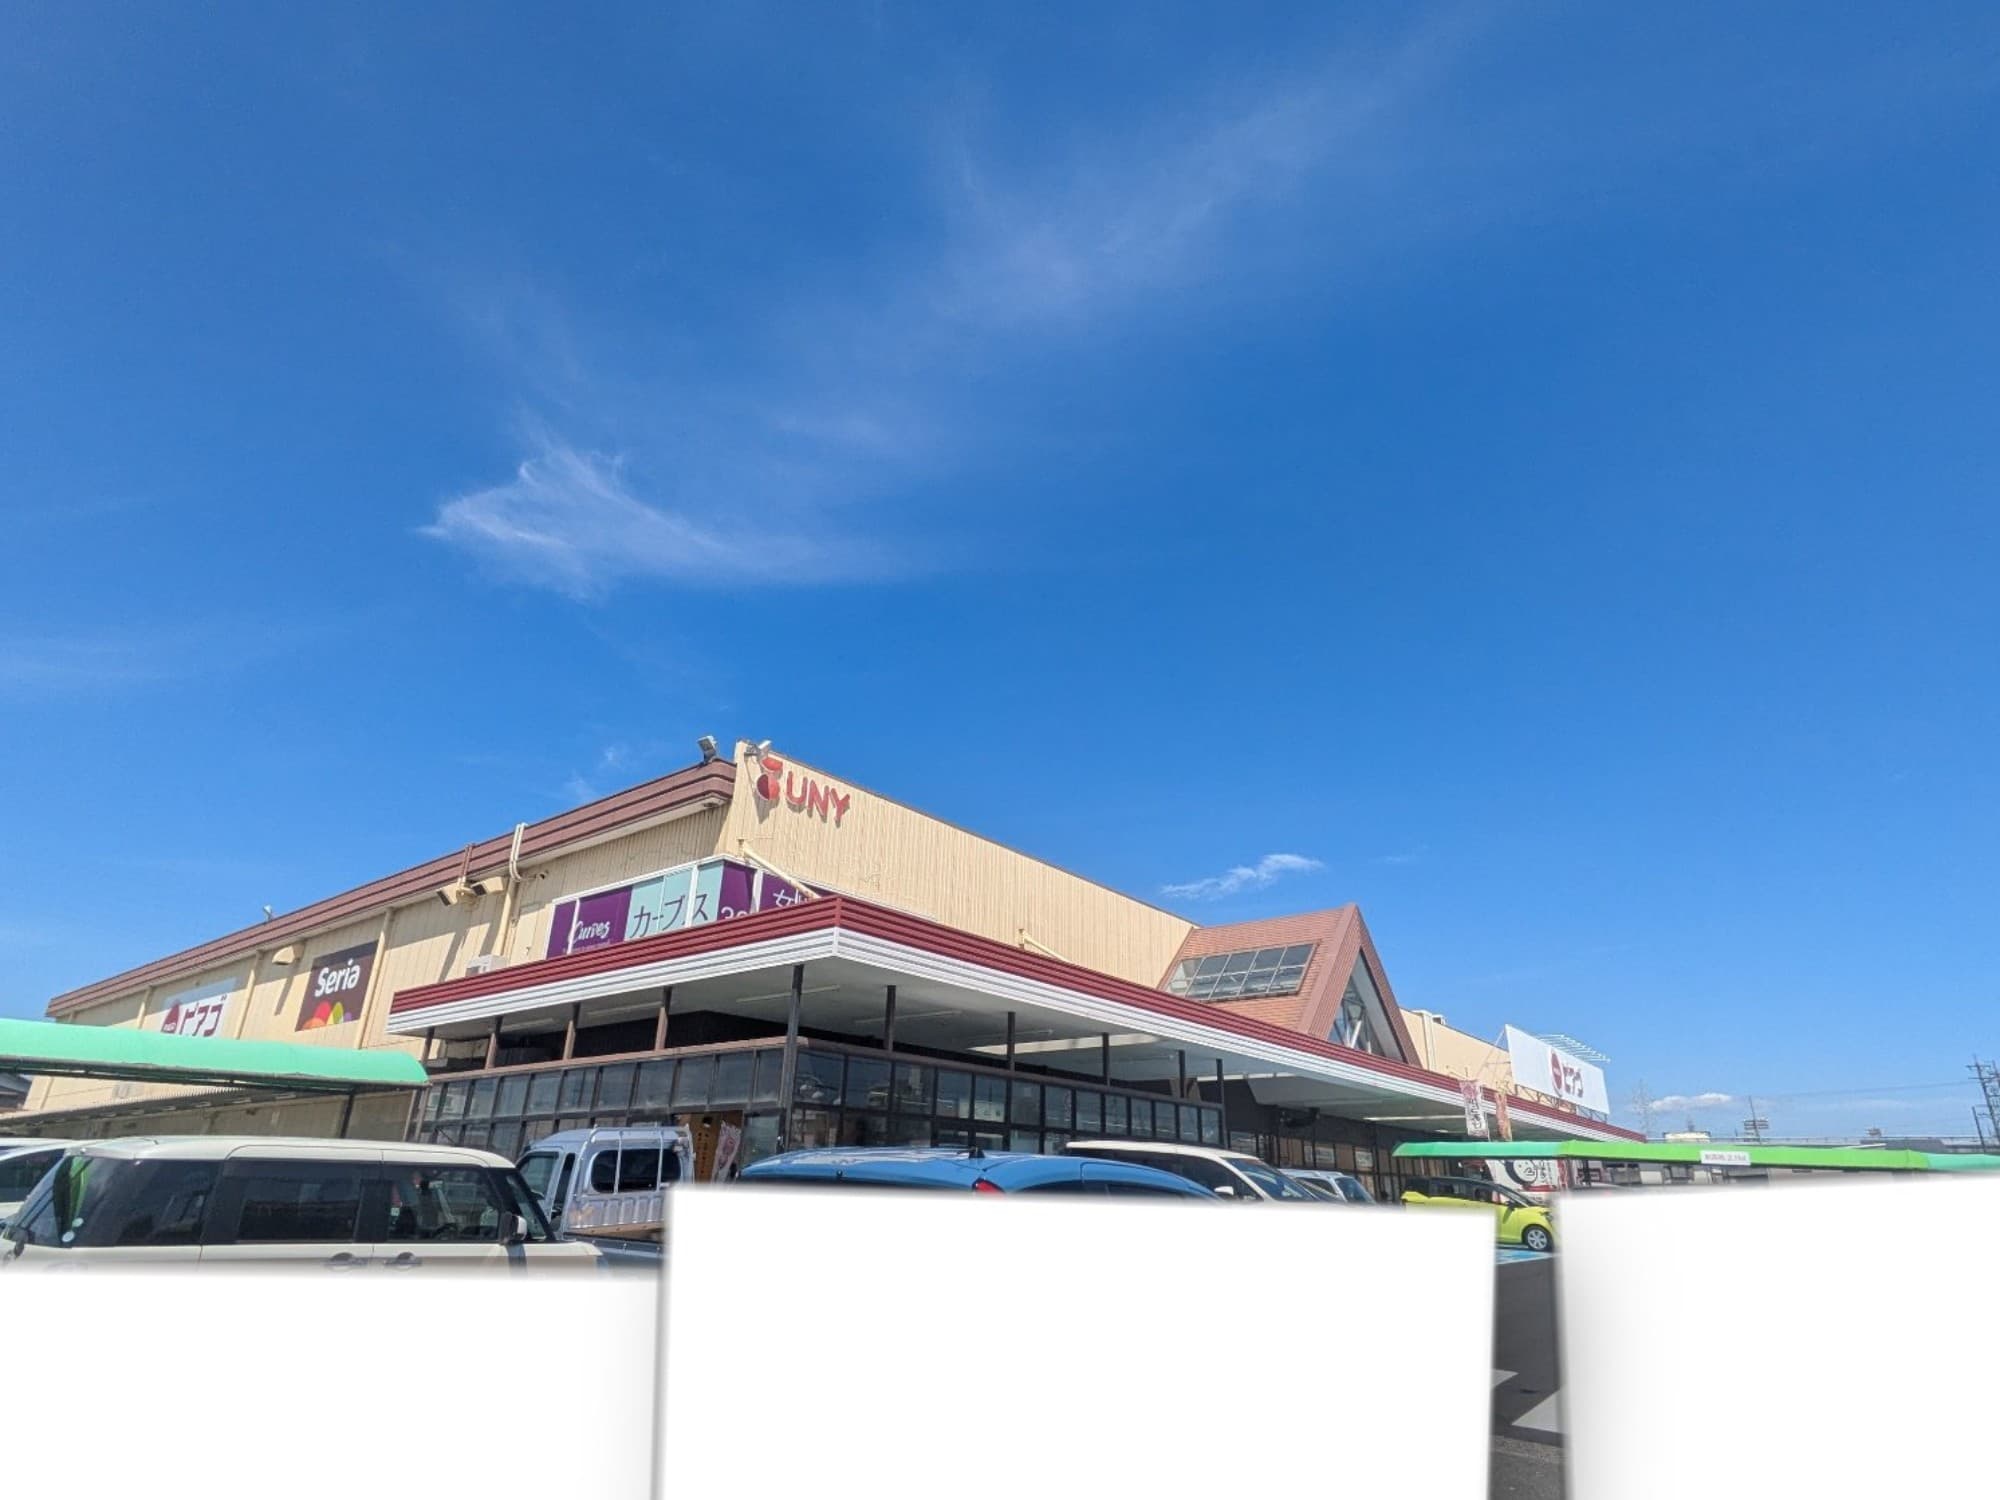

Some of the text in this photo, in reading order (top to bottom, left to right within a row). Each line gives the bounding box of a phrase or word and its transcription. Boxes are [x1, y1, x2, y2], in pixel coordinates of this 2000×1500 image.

[786, 770, 850, 823] UNY
[568, 920, 611, 944] Curves
[630, 893, 708, 938] カーブス
[314, 957, 361, 997] Seria
